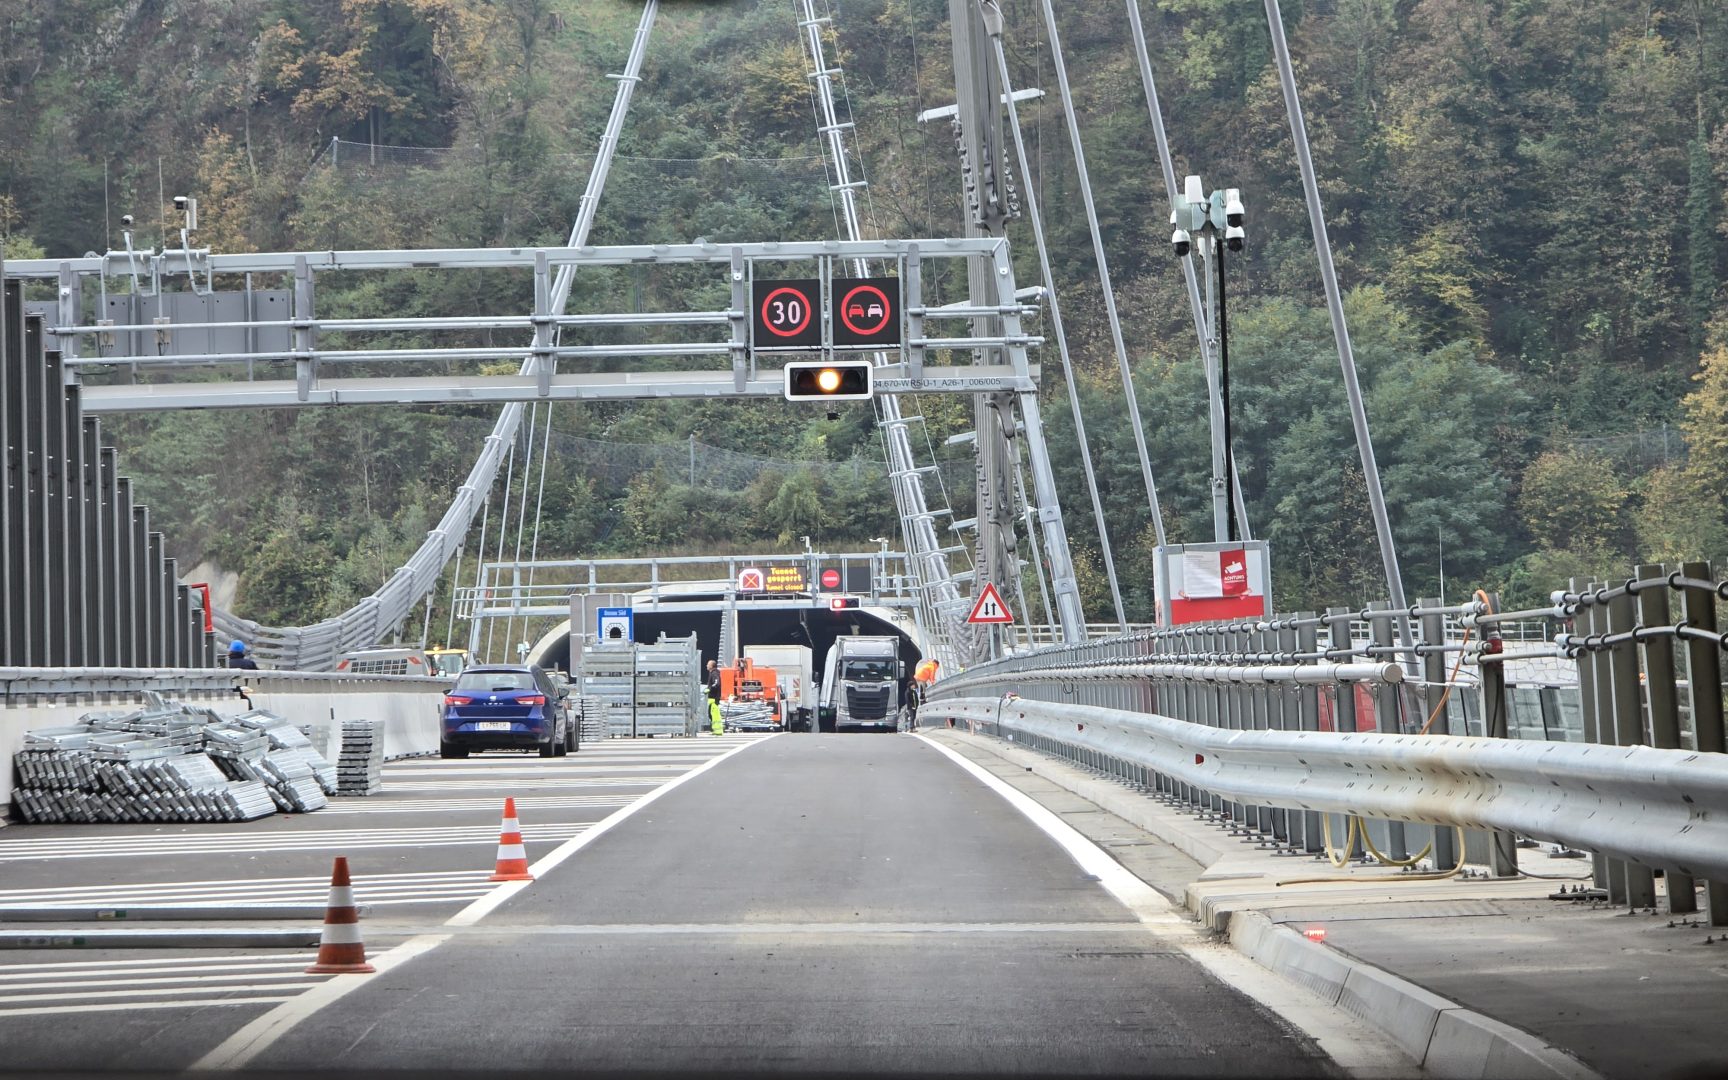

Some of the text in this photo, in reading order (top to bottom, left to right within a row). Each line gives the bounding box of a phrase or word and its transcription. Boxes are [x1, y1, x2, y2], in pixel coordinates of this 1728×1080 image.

[772, 301, 801, 325] 30
[770, 567, 797, 575] Tunnel
[766, 574, 802, 583] gesperrt
[765, 583, 804, 591] Tunnel closed
